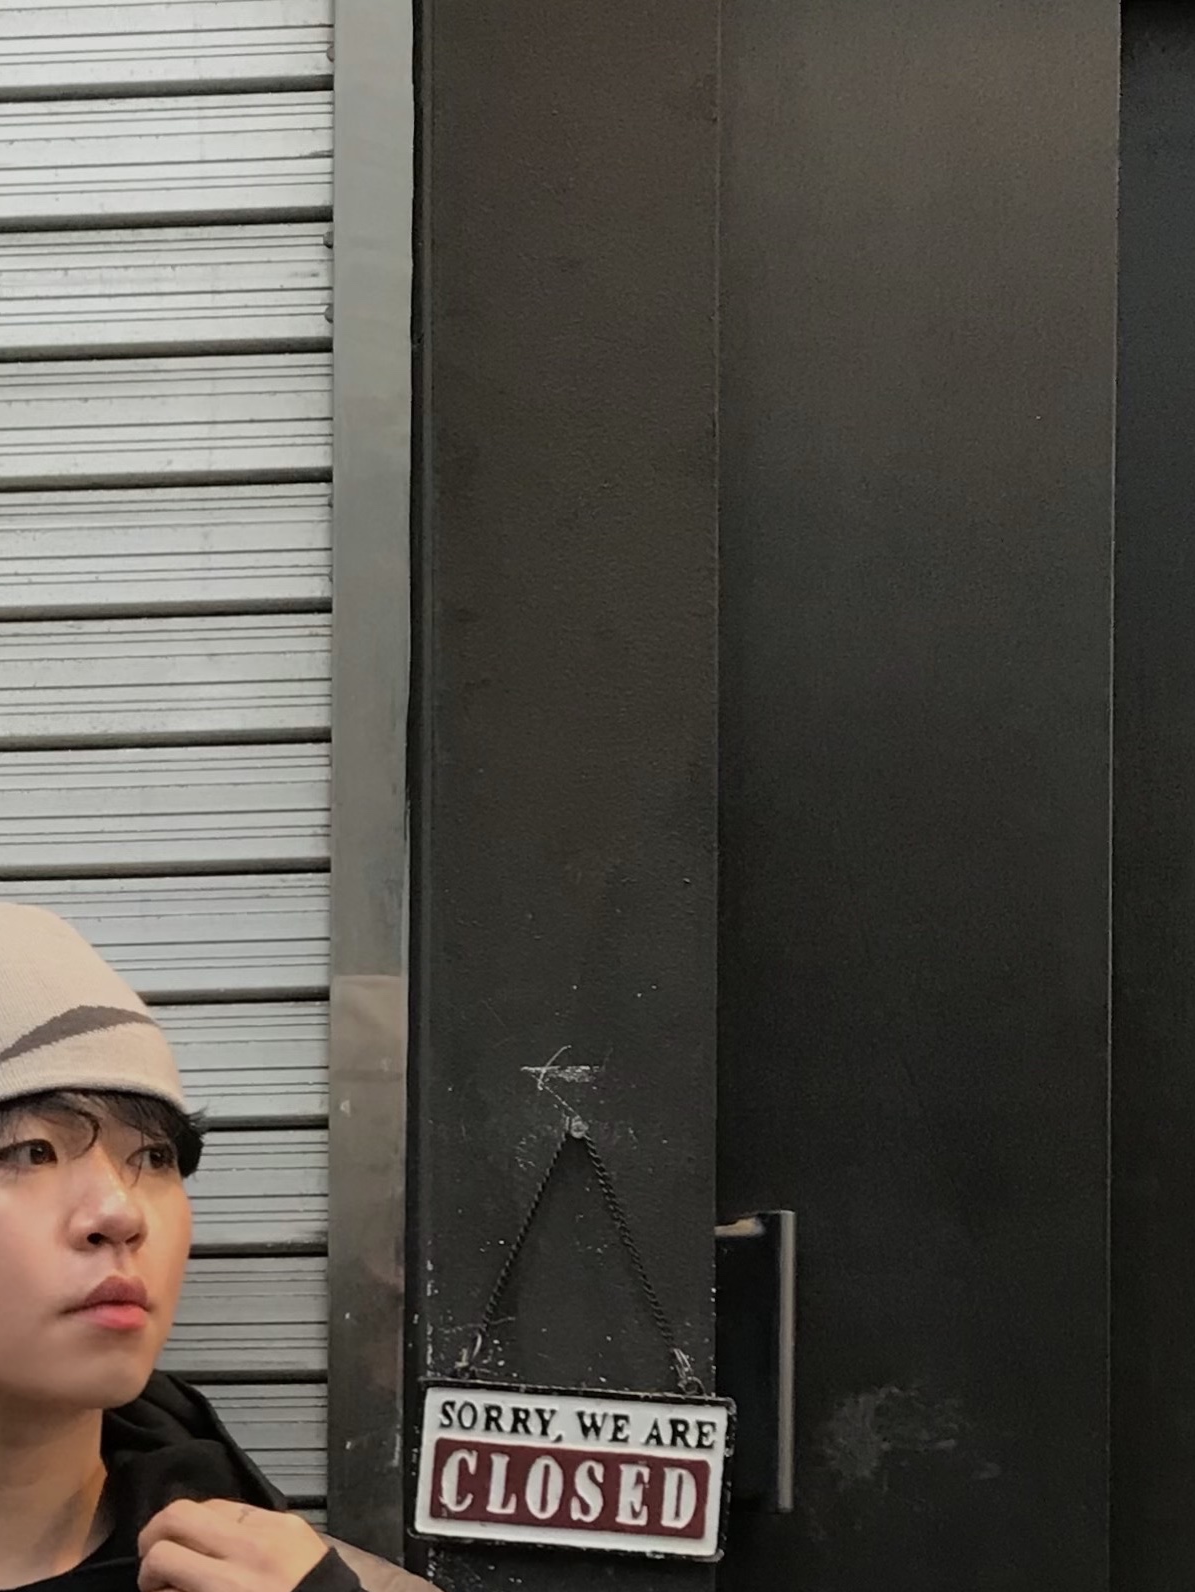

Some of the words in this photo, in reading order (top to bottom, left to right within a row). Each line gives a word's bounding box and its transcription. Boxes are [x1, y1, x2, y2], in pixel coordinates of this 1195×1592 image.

[440, 1401, 562, 1443] SORRY,
[576, 1411, 630, 1443] WE
[643, 1418, 717, 1449] ARE
[440, 1449, 698, 1529] CLOSED
